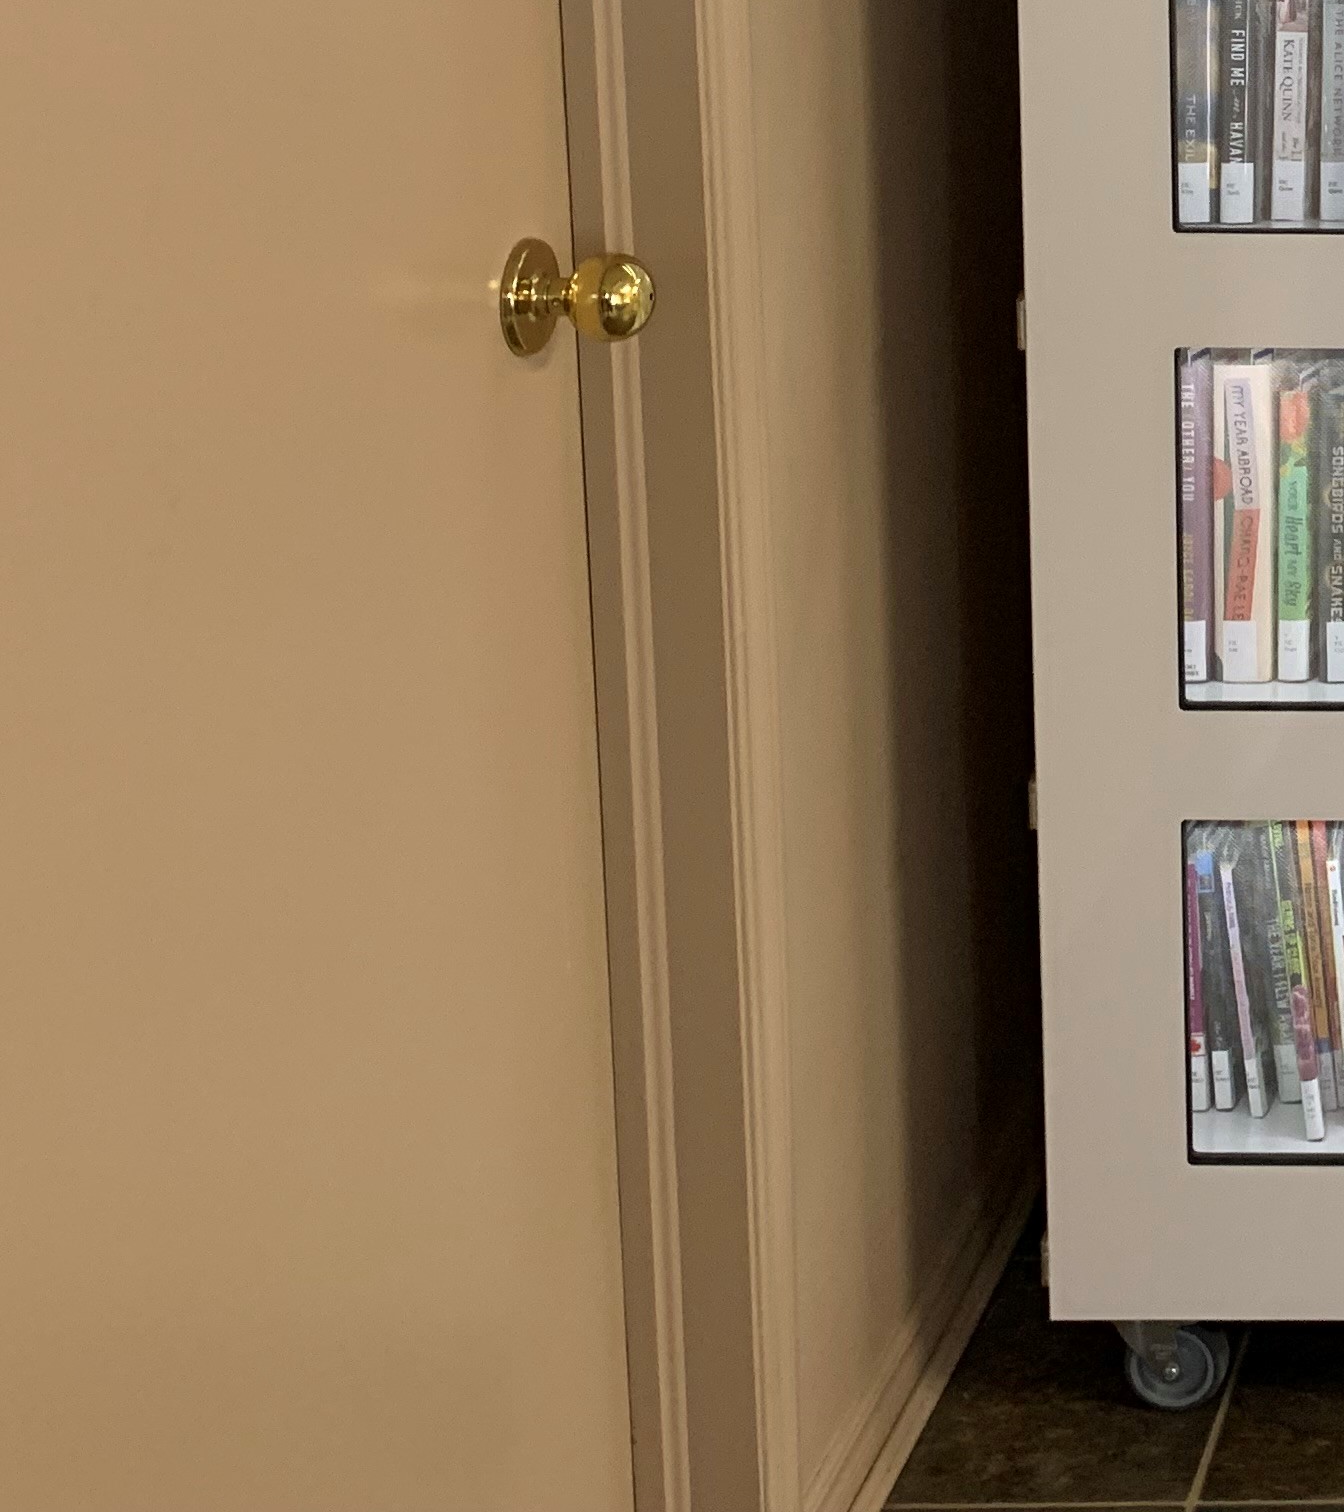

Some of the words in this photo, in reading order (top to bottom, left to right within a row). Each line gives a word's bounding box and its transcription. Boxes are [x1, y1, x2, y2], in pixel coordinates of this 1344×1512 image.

[1230, 29, 1244, 61] FIND
[1230, 68, 1244, 86] ME
[1331, 447, 1344, 533] SONGBIRDS
